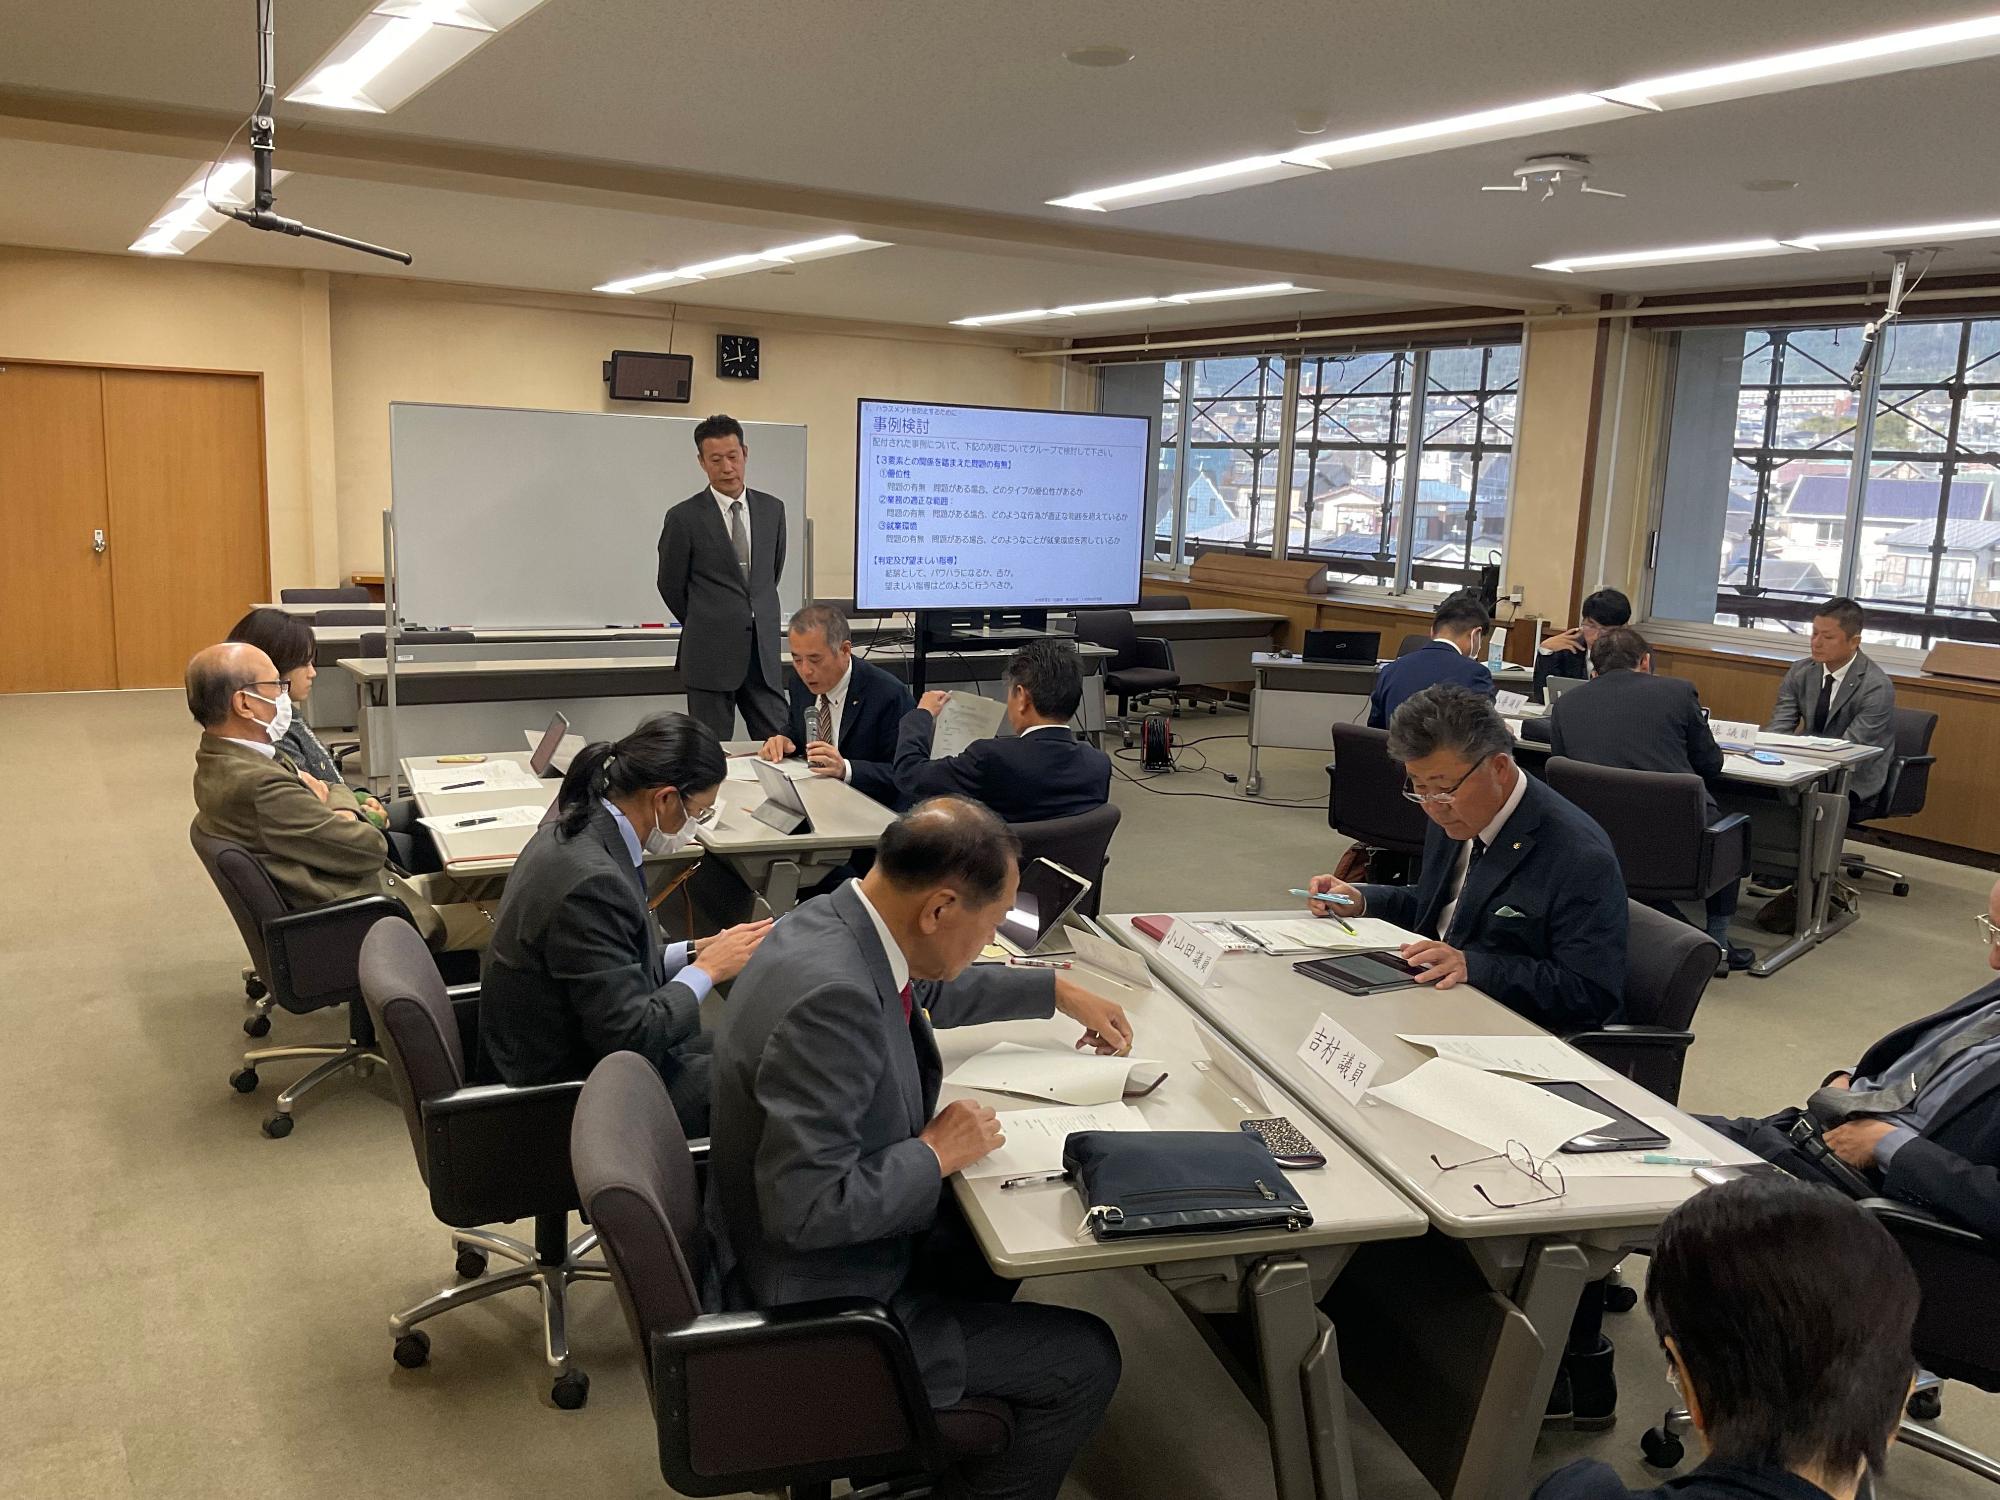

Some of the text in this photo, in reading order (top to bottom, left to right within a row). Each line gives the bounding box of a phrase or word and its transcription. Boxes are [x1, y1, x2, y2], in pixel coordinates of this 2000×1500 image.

[873, 416, 930, 435] 事例検討
[1309, 1026, 1340, 1065] 吉村
